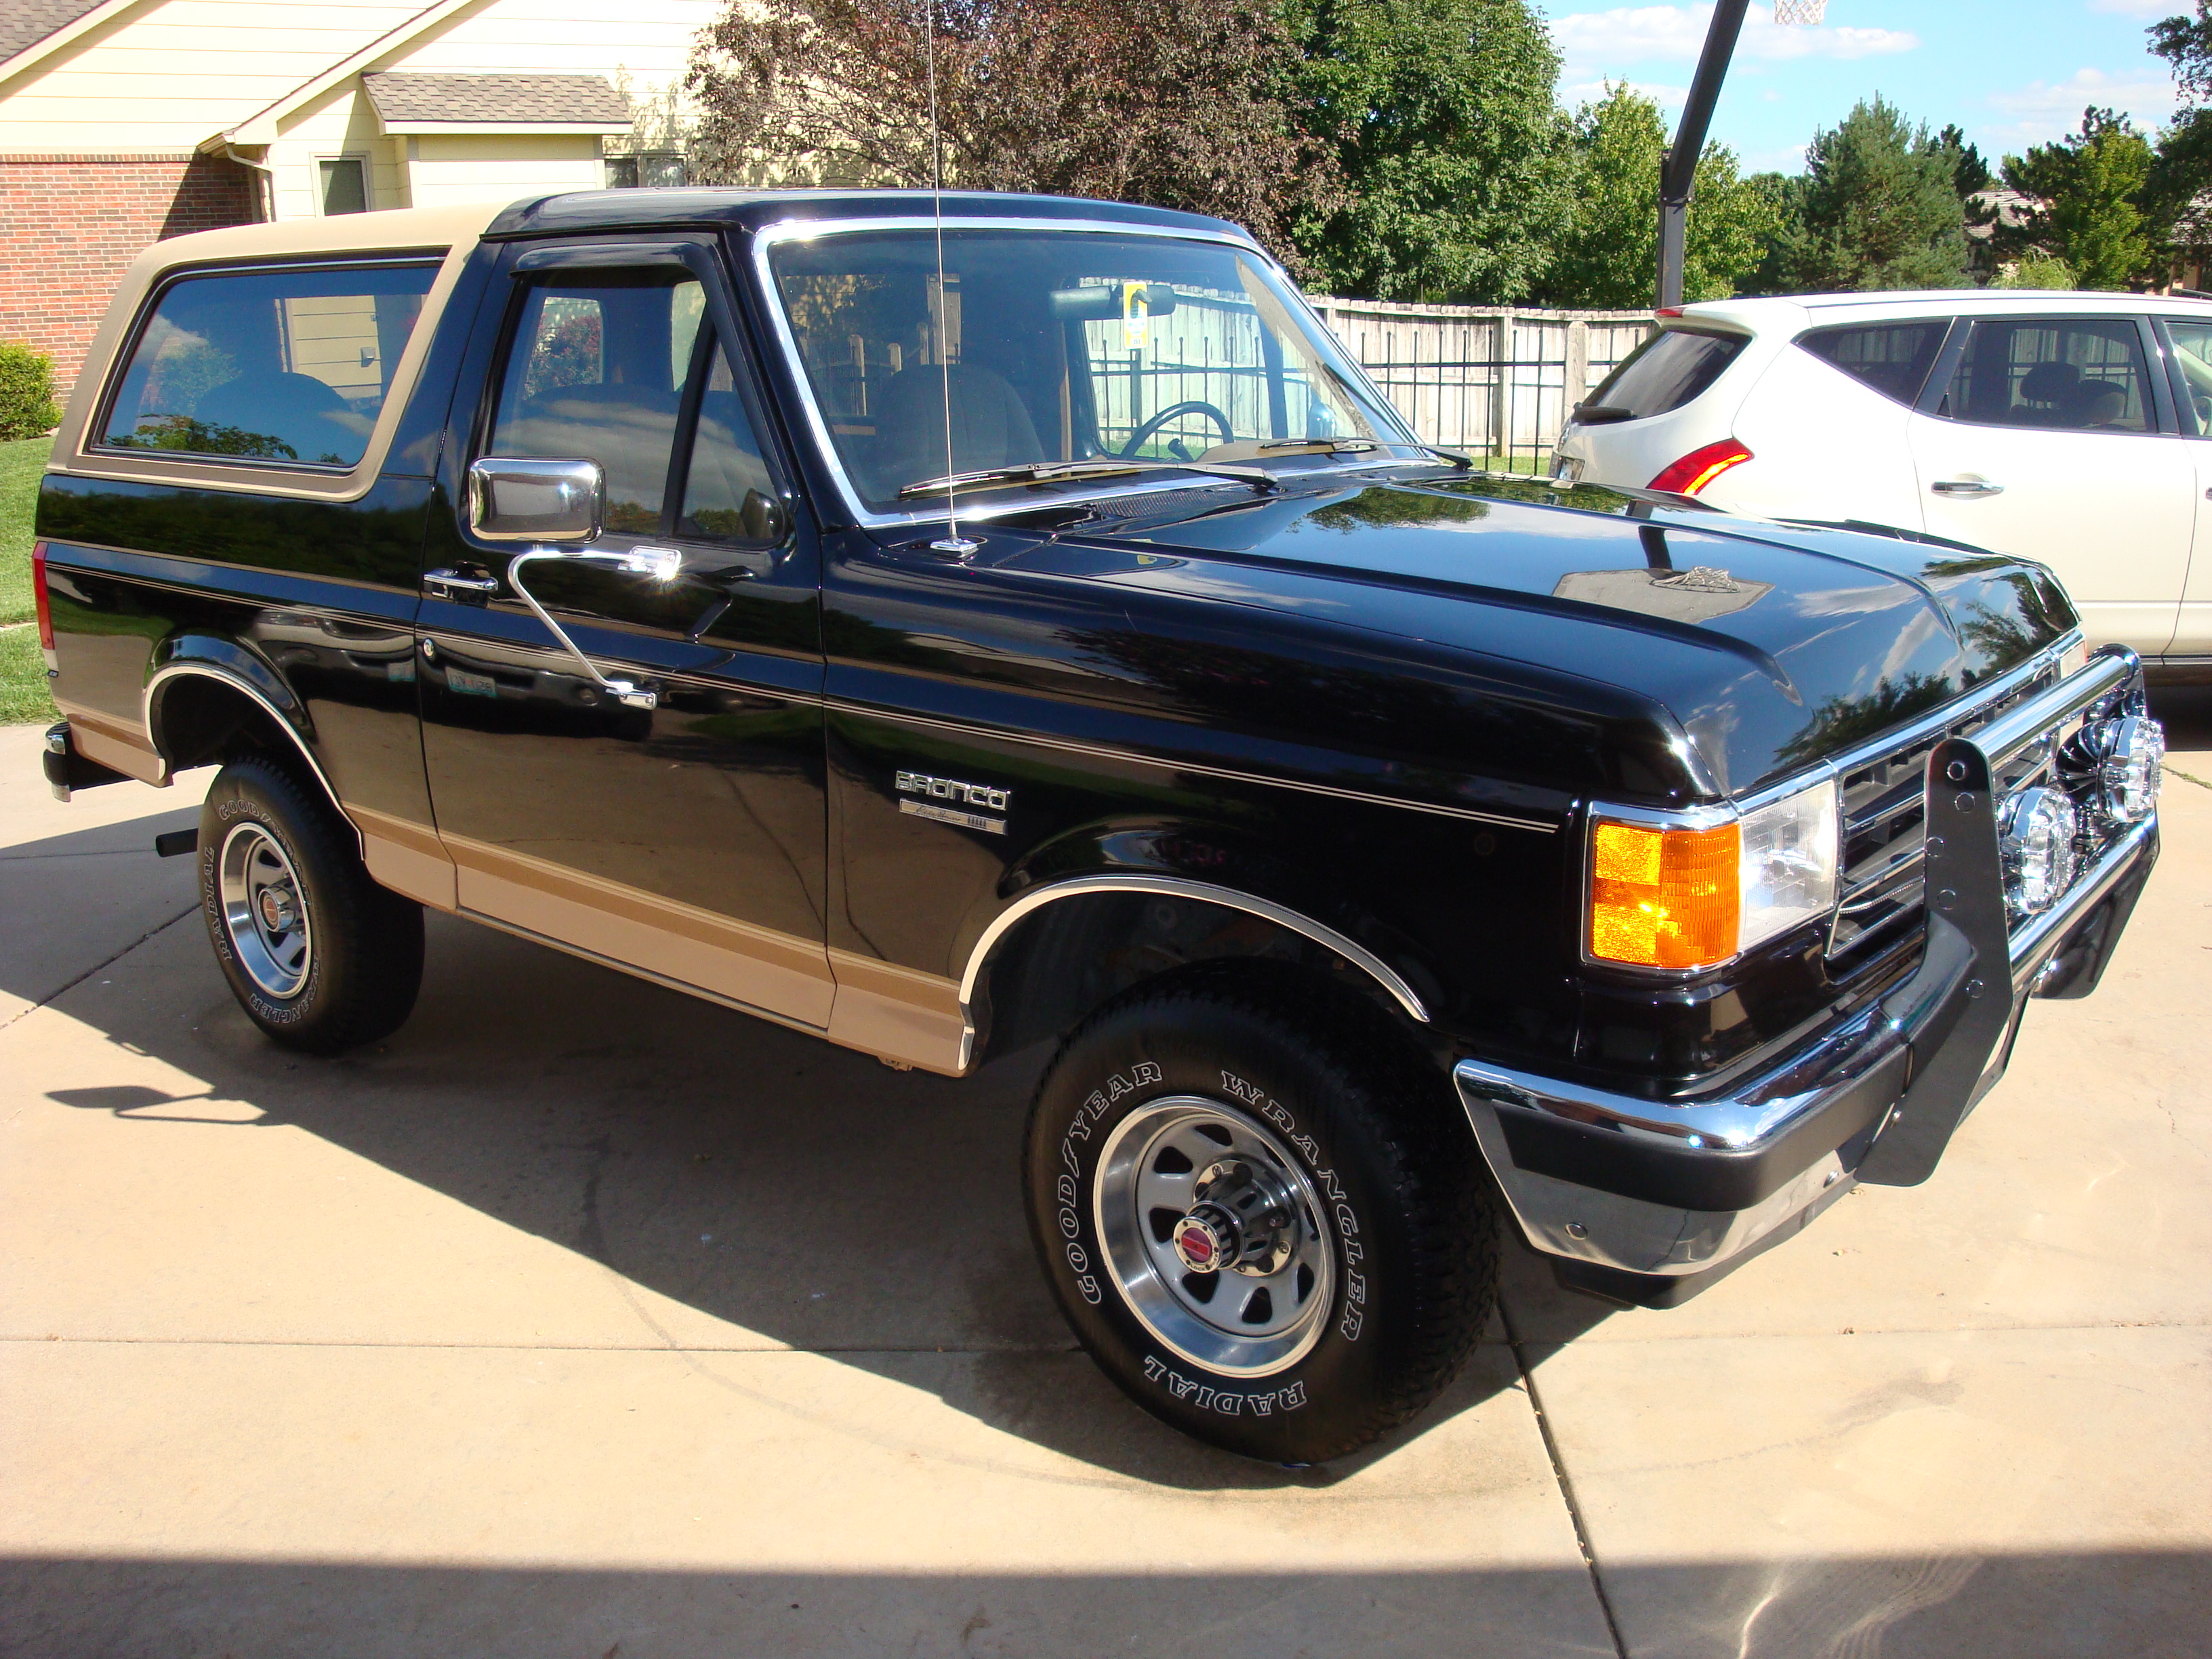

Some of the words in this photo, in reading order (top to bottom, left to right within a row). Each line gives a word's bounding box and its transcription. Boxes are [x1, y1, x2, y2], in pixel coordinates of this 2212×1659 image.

[204, 846, 232, 960] RADIAL
[249, 954, 320, 1023] WRANGLER
[1221, 1069, 1366, 1341] WRANGLER
[1143, 1355, 1307, 1416] RADIAL
